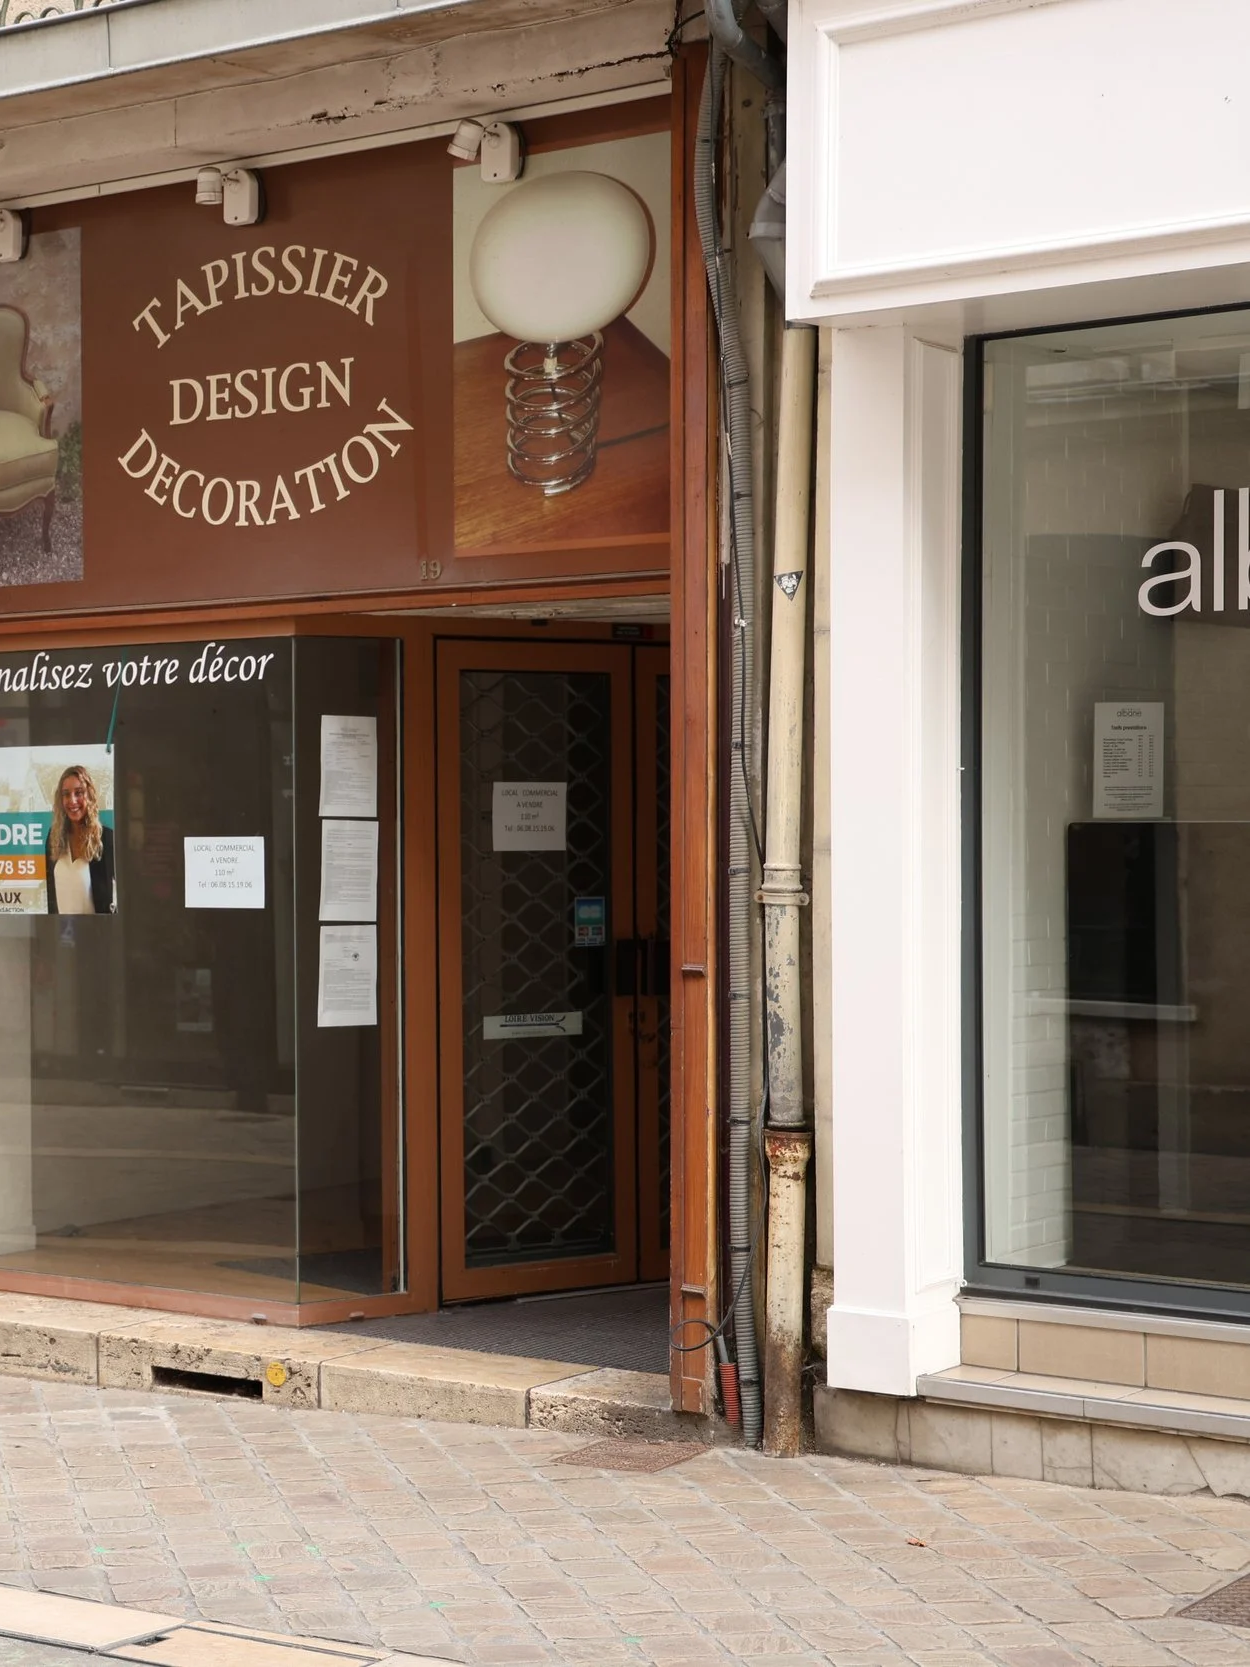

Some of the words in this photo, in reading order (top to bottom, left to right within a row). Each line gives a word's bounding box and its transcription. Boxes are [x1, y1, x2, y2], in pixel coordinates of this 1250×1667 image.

[132, 245, 388, 349] TAPISSIER
[169, 357, 354, 425] DESIGN
[117, 397, 414, 526] DECORATION
[421, 560, 442, 580] 19
[102, 656, 178, 688] votre
[189, 642, 273, 684] décor
[17, 860, 35, 875] 55
[504, 1014, 528, 1023] LOIRE
[530, 1013, 555, 1022] VISION
